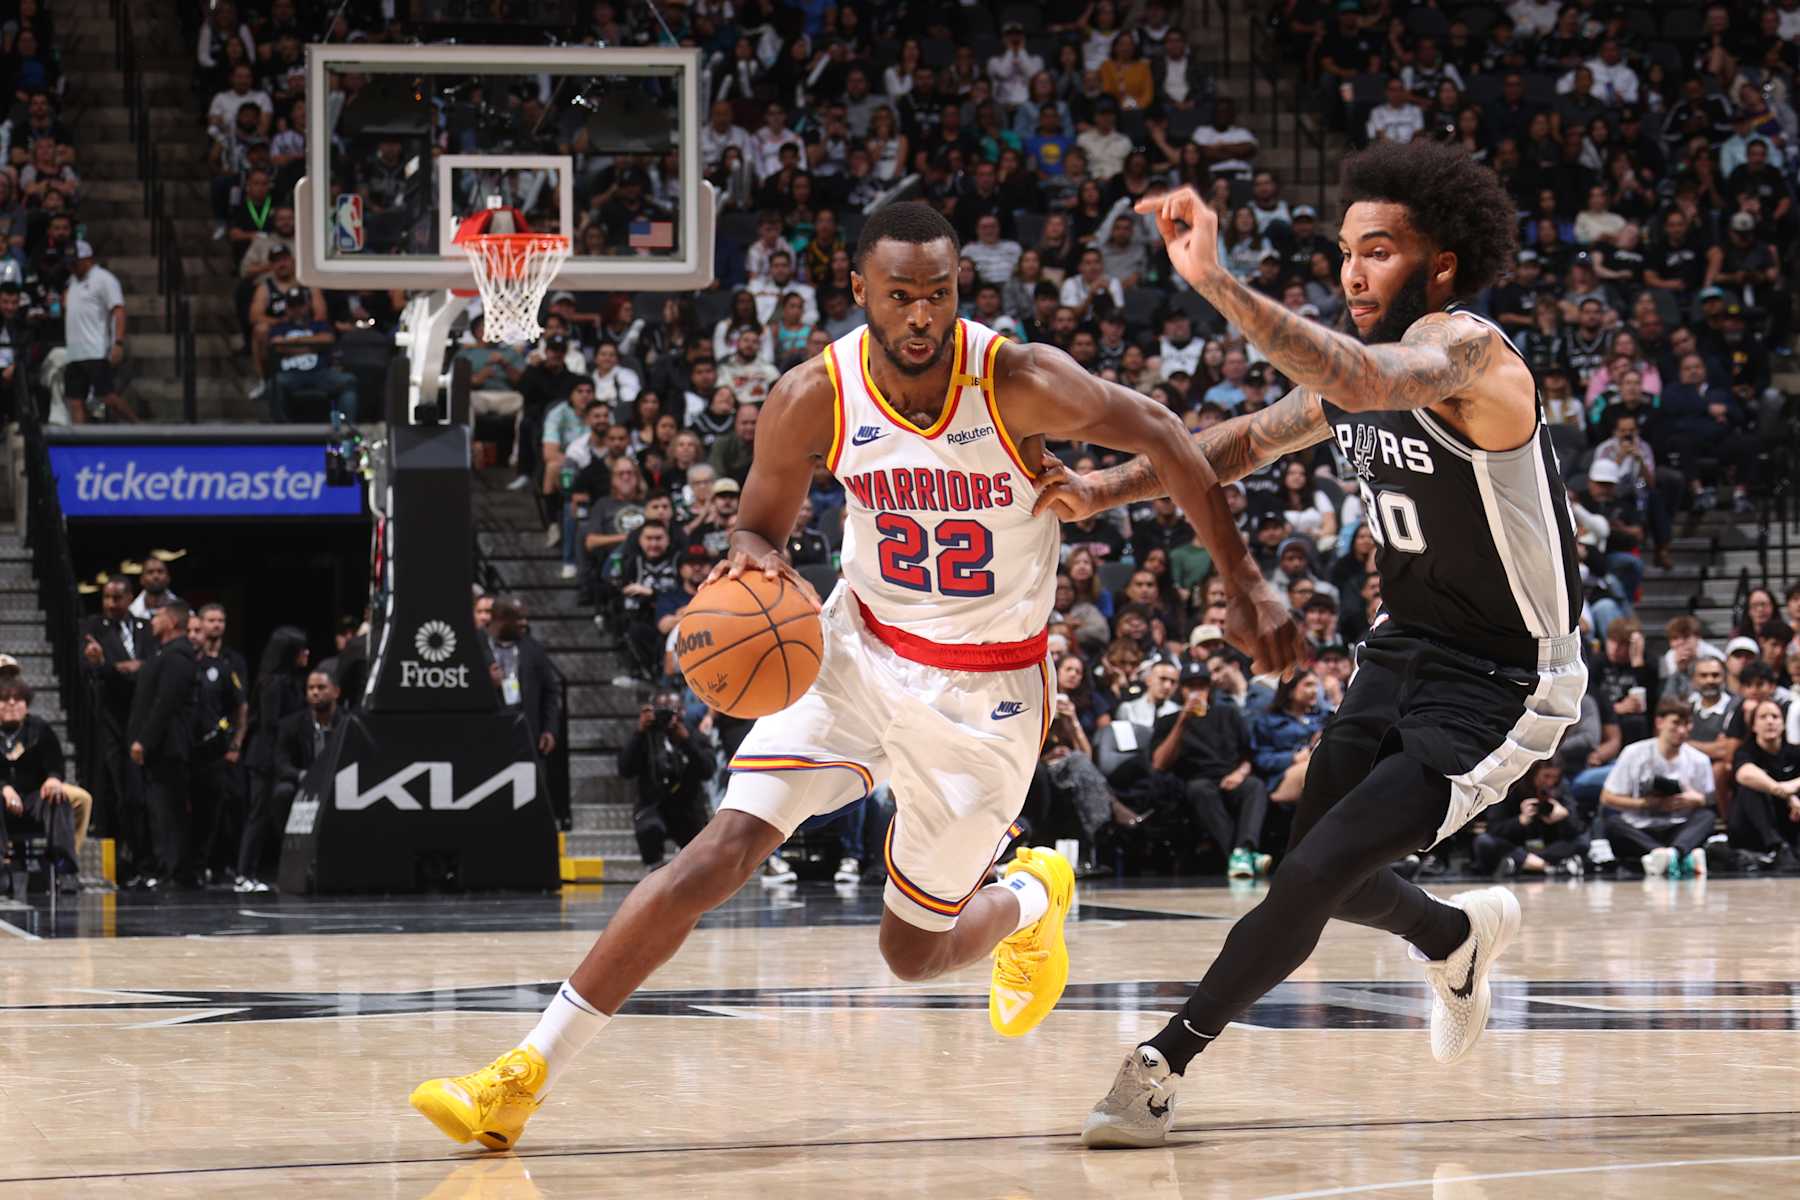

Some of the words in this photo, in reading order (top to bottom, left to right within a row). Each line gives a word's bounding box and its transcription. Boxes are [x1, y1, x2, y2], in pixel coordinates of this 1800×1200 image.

[857, 425, 881, 439] NIKE
[946, 426, 994, 445] Rakuten
[1329, 423, 1435, 481] PURS
[75, 461, 327, 501] ticketmaster
[844, 467, 1014, 512] WARRIORS
[875, 511, 996, 598] 22
[399, 660, 469, 689] Frost
[997, 700, 1023, 714] NIKE
[335, 761, 537, 811] KIA
